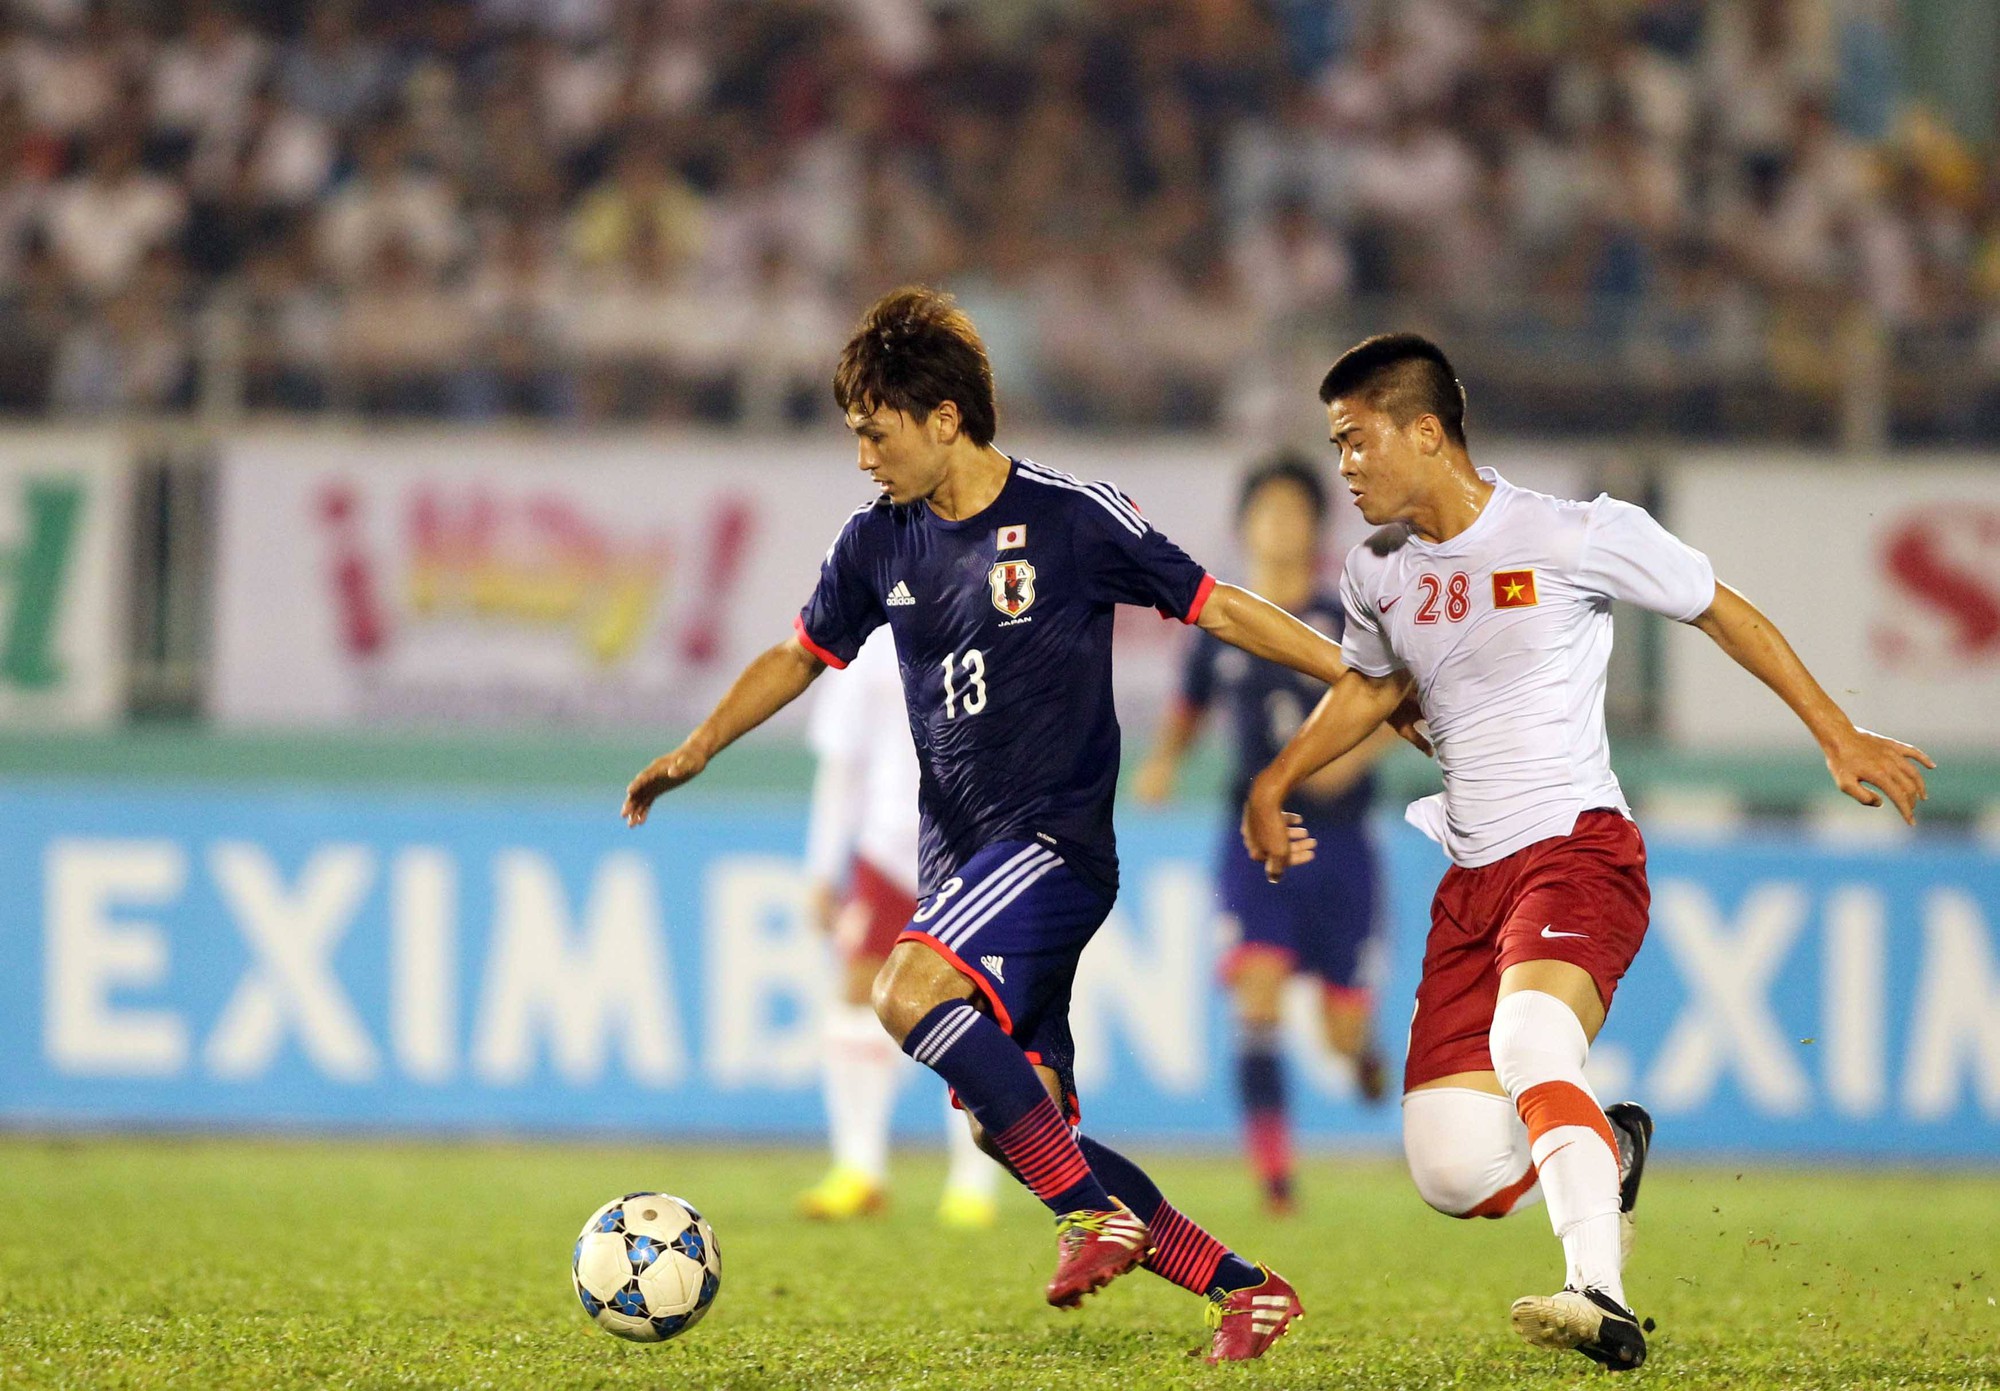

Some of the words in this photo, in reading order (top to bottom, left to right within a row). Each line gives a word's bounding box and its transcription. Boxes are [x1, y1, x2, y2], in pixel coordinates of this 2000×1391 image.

[997, 566, 1027, 579] JFA
[886, 596, 916, 606] adidas
[1414, 571, 1470, 624] 28
[998, 616, 1032, 627] JAPAN
[941, 649, 987, 719] 13
[913, 876, 963, 923] 3
